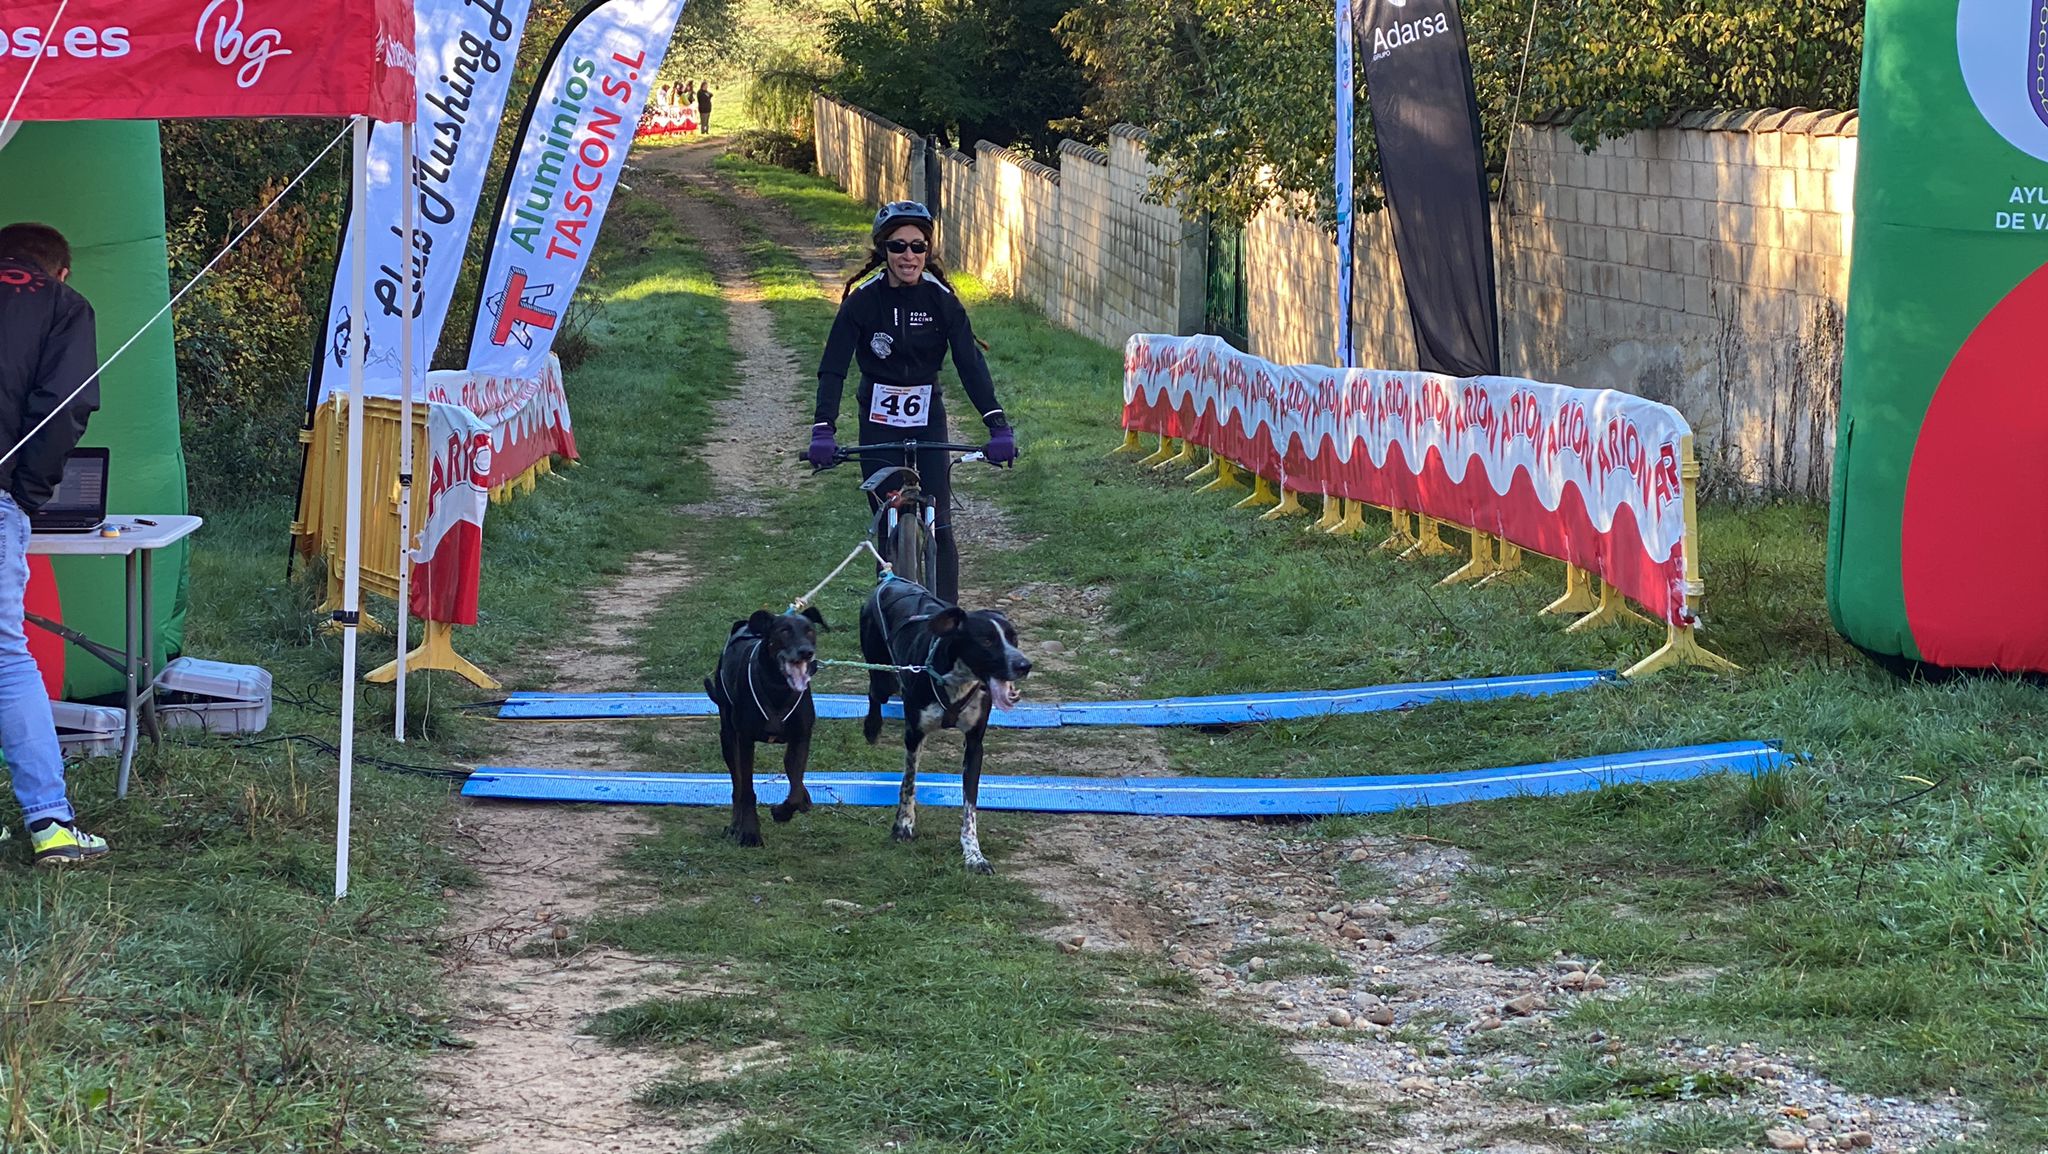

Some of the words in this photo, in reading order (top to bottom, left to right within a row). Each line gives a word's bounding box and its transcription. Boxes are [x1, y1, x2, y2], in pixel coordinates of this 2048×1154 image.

[1372, 50, 1391, 61] GRUPO
[1373, 12, 1449, 54] Adarsa
[412, 30, 501, 225] Mushing
[510, 56, 596, 254] Aluminios
[545, 105, 623, 260] TASCON
[602, 50, 646, 104] S.L
[1996, 212, 2025, 229] DE
[880, 394, 922, 417] 46
[1344, 378, 1375, 437] ARION
[1378, 378, 1412, 441] ARION
[1414, 380, 1451, 446] ARION
[1455, 385, 1499, 456] ARION
[1501, 390, 1545, 468] ARION
[1548, 400, 1594, 486] ARION
[1598, 415, 1652, 511] ARION
